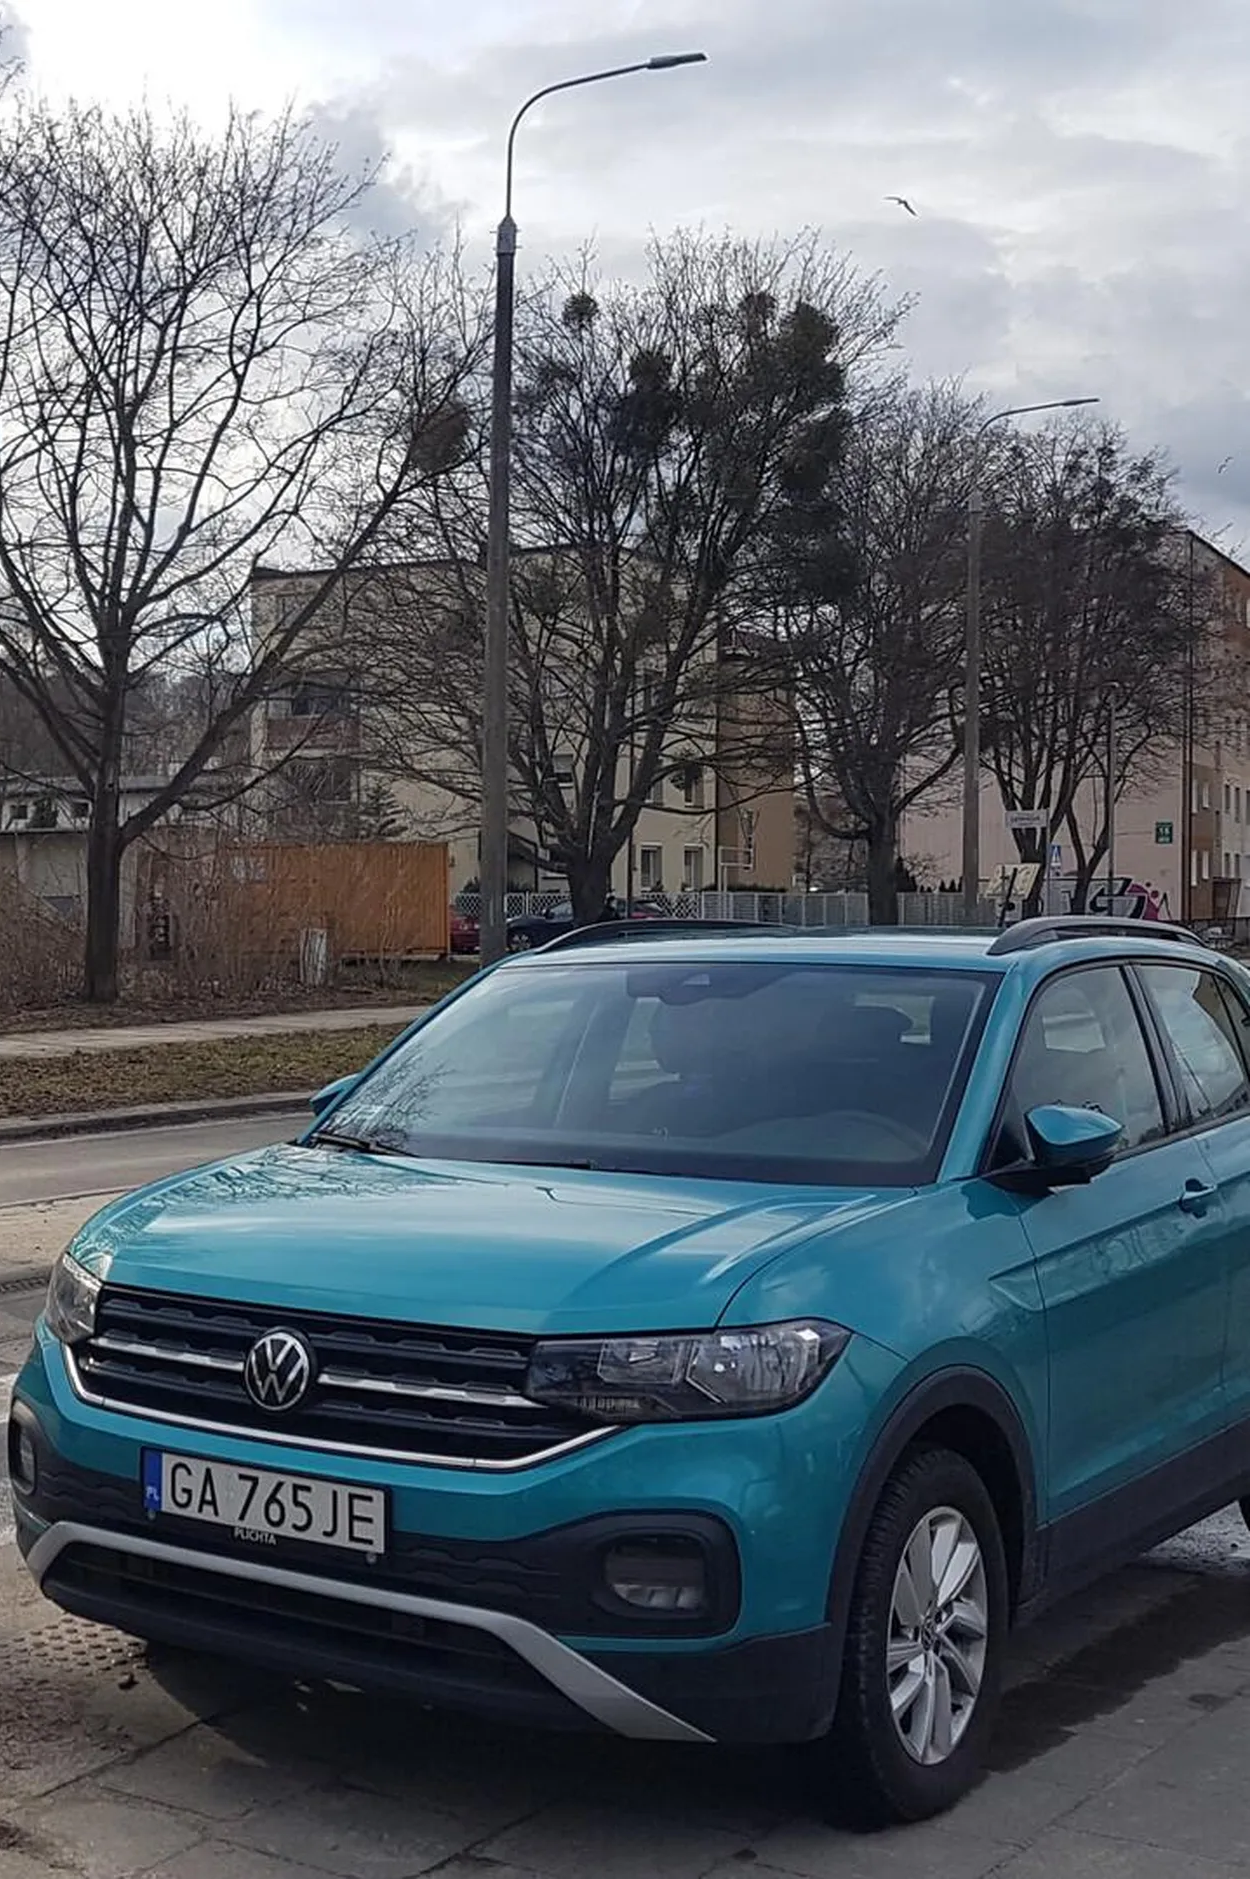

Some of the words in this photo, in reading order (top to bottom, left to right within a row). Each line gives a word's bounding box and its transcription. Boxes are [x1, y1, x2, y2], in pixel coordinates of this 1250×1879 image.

[246, 1331, 309, 1411] VW
[170, 1461, 220, 1517] GA
[237, 1473, 374, 1546] 765JE
